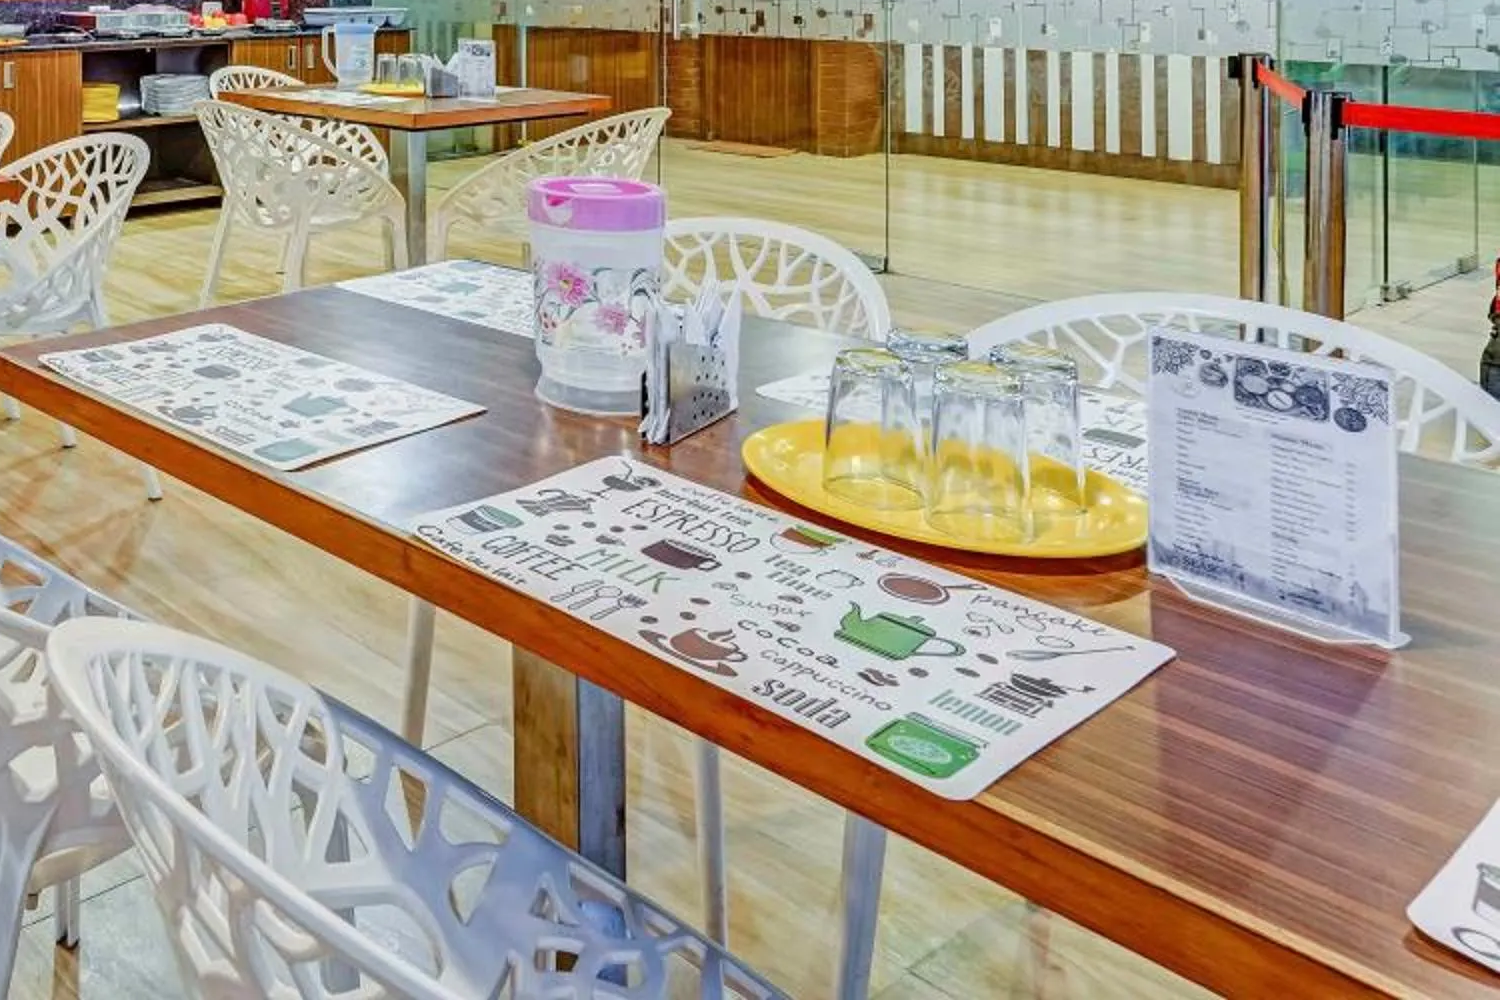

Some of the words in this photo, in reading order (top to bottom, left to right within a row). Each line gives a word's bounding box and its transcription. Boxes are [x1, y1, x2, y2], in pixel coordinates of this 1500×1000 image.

[621, 499, 761, 553] ESPRESSO
[481, 535, 588, 581] COFFEE
[575, 550, 681, 594] MILK
[763, 553, 811, 576] tea
[767, 570, 834, 601] time
[752, 678, 852, 729] soda
[927, 688, 1025, 736] lemon
